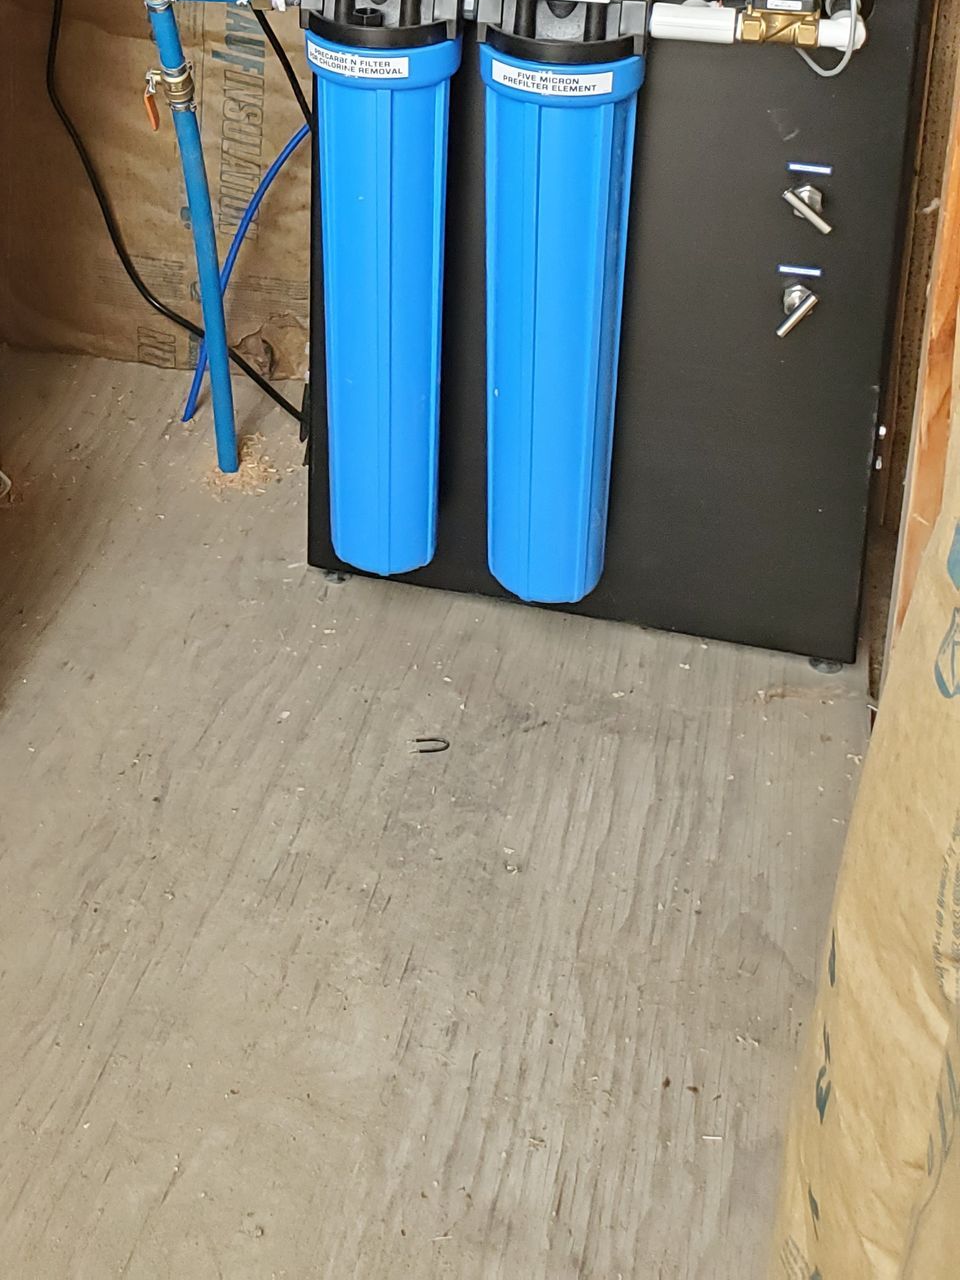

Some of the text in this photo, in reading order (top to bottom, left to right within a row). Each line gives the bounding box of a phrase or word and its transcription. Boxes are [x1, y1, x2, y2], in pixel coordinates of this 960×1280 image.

[314, 47, 391, 68] PRECARBN FILTER
[319, 57, 356, 74] CHLORINE
[358, 66, 403, 75] REMOVAL
[503, 74, 597, 93] PREFILTER ELEMENT
[517, 71, 580, 85] FIVE MICRON
